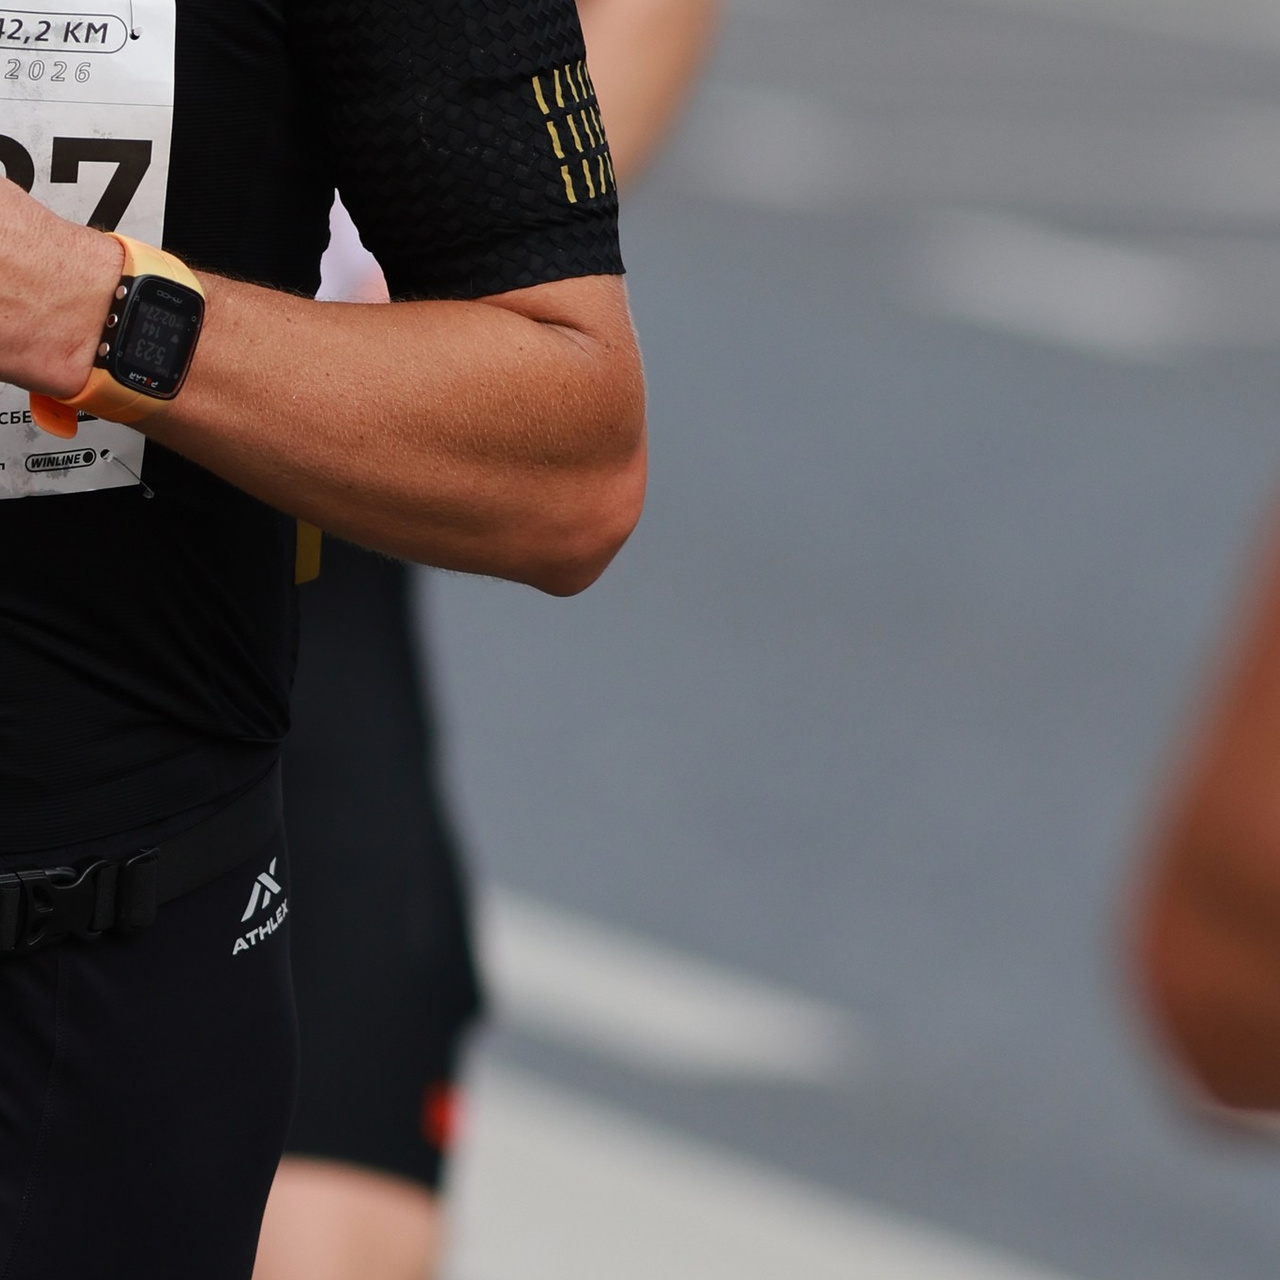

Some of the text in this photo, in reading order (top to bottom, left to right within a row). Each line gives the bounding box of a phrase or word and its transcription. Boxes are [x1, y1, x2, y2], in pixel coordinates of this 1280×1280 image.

[4, 58, 91, 83] 2026
[30, 453, 81, 469] WINLINE
[232, 898, 288, 955] ATHLEX
